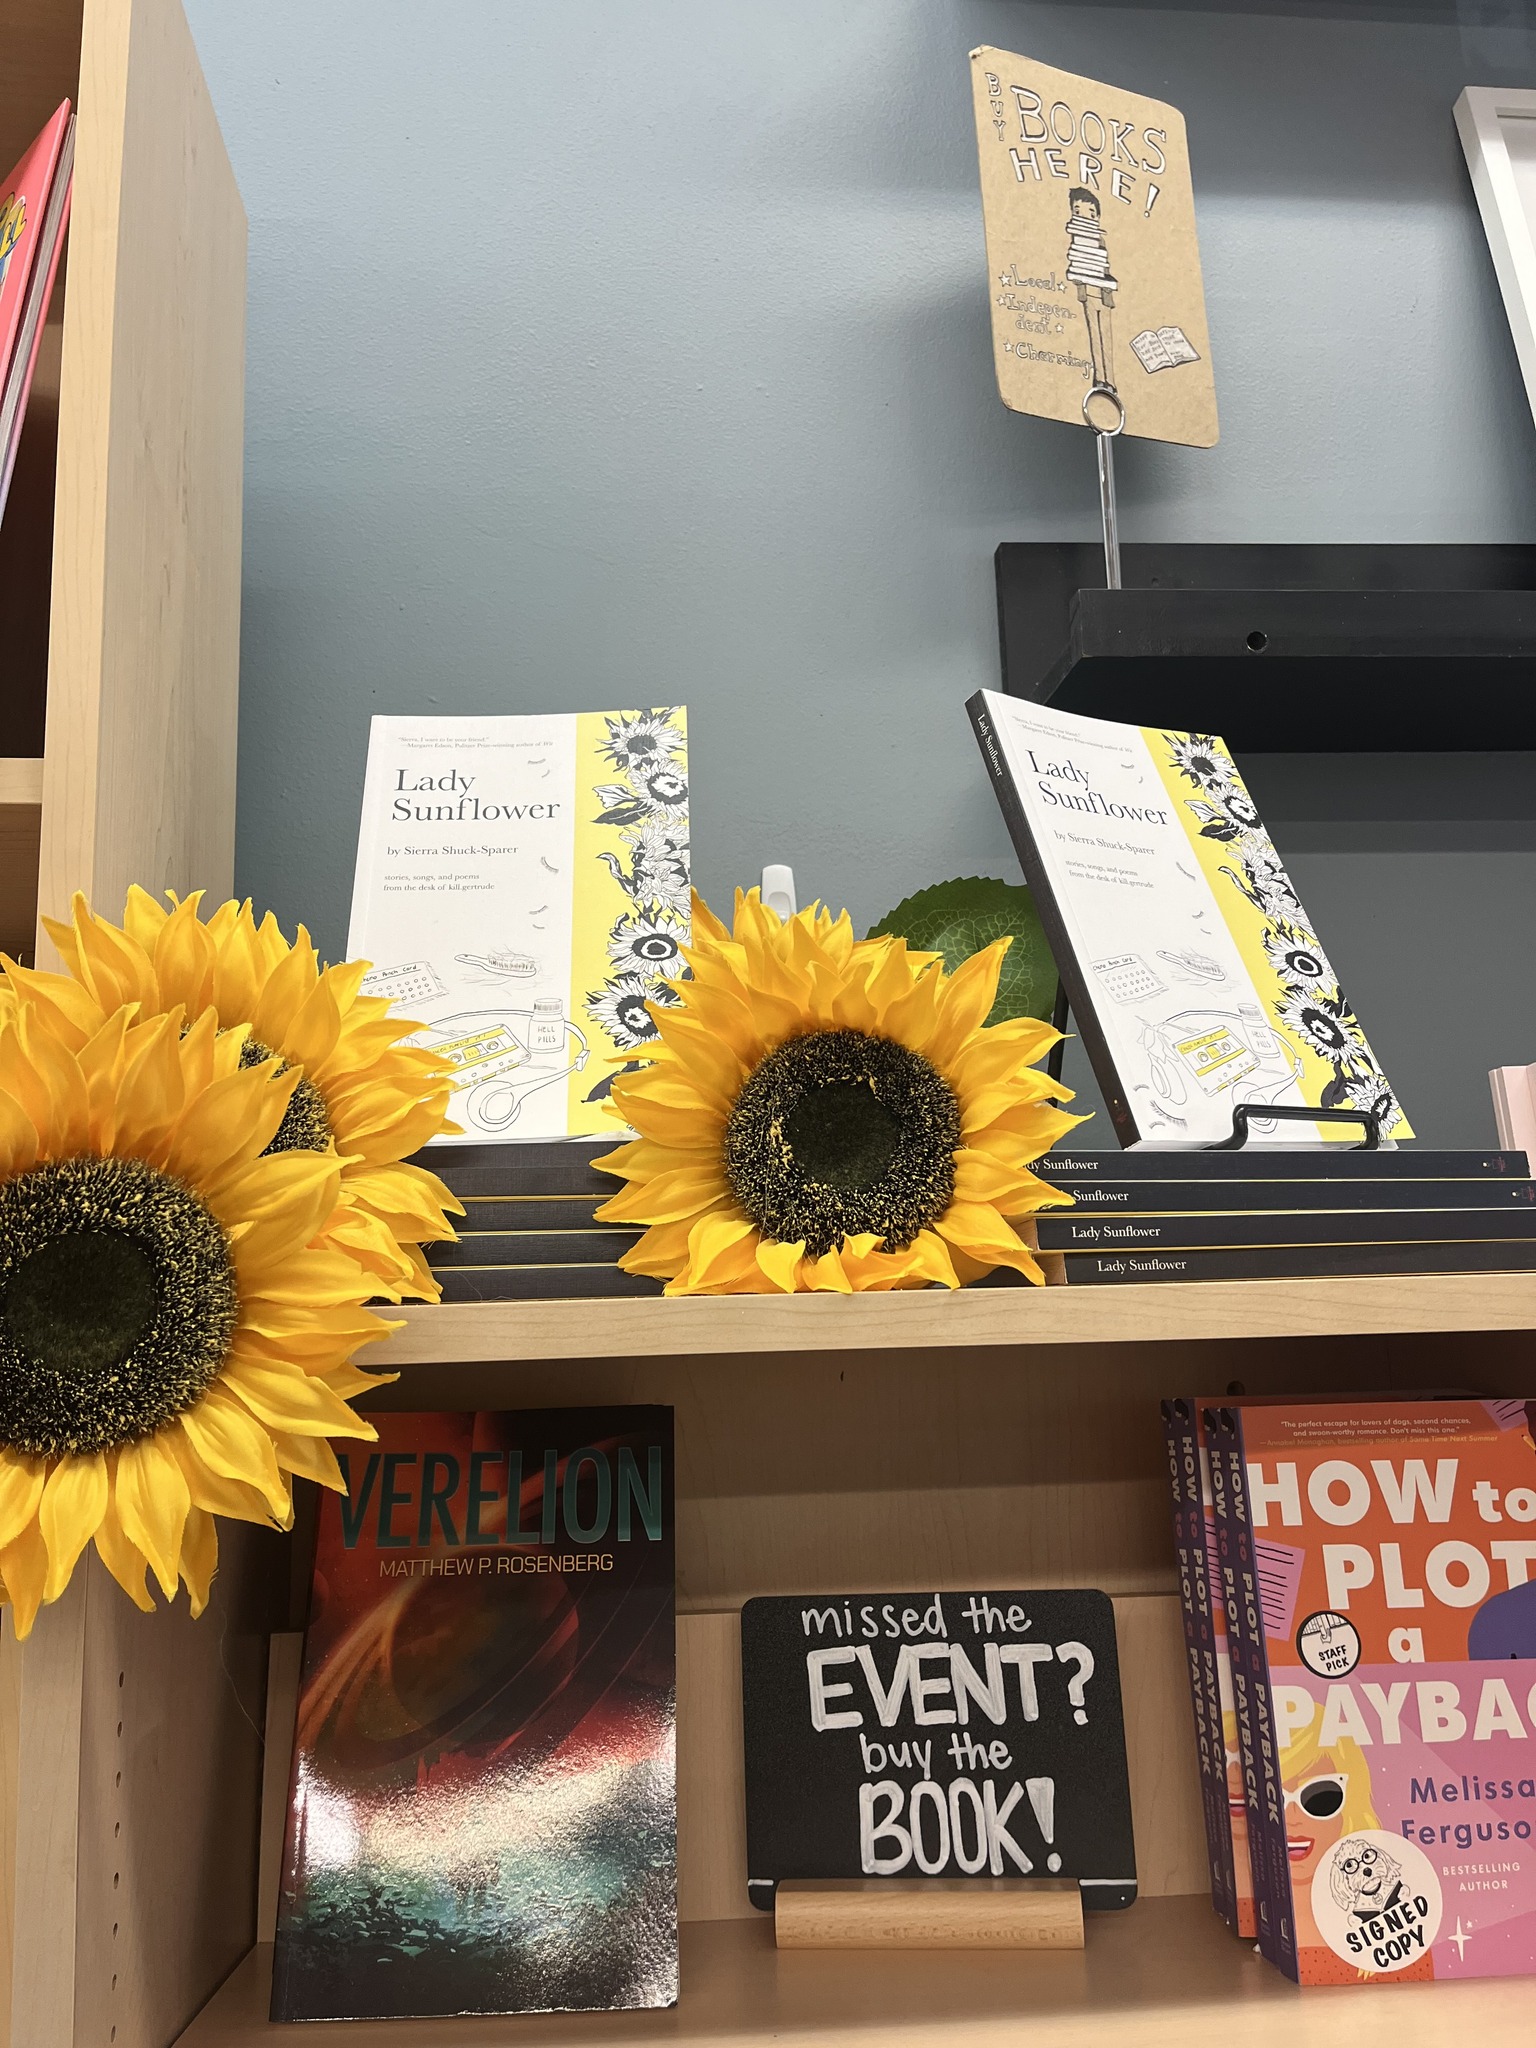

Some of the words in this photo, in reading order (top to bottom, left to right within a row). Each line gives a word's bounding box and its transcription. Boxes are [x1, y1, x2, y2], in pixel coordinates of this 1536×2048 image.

[985, 73, 1006, 141] BUY
[1010, 85, 1166, 175] BOOKS
[1009, 148, 1160, 218] HERE!
[1010, 264, 1055, 291] Local
[1015, 314, 1051, 335] dent
[1016, 342, 1094, 379] Charming
[978, 713, 989, 736] Lady
[985, 735, 1003, 777] Sunflower
[394, 769, 476, 798] Lady
[1025, 749, 1090, 791] Lady
[392, 798, 560, 821] Sunflower
[1038, 780, 1168, 825] Sunflower
[387, 846, 401, 857] by
[404, 846, 439, 855] Sierra
[442, 845, 519, 857] Shuck-Sparer
[1054, 830, 1066, 842] by
[1067, 832, 1095, 846] Sierra
[1096, 838, 1155, 855] Shuck-Sparer
[384, 874, 411, 882] stories,
[1023, 1158, 1040, 1172] dy
[1043, 1158, 1099, 1170] Sunflower
[1073, 1189, 1129, 1201] Sunflower
[1072, 1226, 1100, 1241] Lady
[1104, 1225, 1161, 1238] Sunflower
[1097, 1260, 1126, 1274] Lady
[1129, 1259, 1186, 1271] Sunflower
[1298, 1420, 1322, 1429] perfect
[1393, 1418, 1412, 1427] dogs,
[1309, 1429, 1355, 1437] swoon-worthy
[338, 1446, 662, 1550] VERELION
[1211, 1451, 1227, 1519] HOW
[1229, 1452, 1246, 1522] HOW
[1246, 1459, 1459, 1527] HOW
[1472, 1481, 1536, 1523] to
[1219, 1527, 1228, 1557] to
[1238, 1532, 1247, 1561] to
[380, 1559, 474, 1577] MATTHEW
[478, 1558, 492, 1575] P.
[497, 1553, 614, 1575] ROSENBERG
[802, 1593, 948, 1638] missed
[961, 1596, 1032, 1634] the
[1167, 1440, 1181, 1503] HOW
[1179, 1548, 1193, 1615] PLOT
[1189, 1647, 1211, 1776] PAYBACK
[1182, 1436, 1198, 1502] HOW
[1193, 1548, 1208, 1617] PLOT
[1203, 1650, 1224, 1783] PAYBACK
[1223, 1567, 1240, 1638] PLOT
[1242, 1573, 1259, 1647] PLOT
[1318, 1644, 1347, 1661] STAFF
[1388, 1627, 1425, 1663] a
[1326, 1657, 1349, 1672] PICK
[806, 1641, 1095, 1732] EVENT?
[1271, 1678, 1536, 1747] PAYBA
[859, 1733, 931, 1780] buy
[947, 1732, 1013, 1770] the
[1235, 1673, 1259, 1811] PAYBACK
[1254, 1682, 1280, 1826] PAYBACK
[1410, 1775, 1536, 1804] Melissa
[859, 1776, 1062, 1876] BOOK!
[1401, 1819, 1536, 1849] Ferguso
[1442, 1862, 1520, 1876] BESTSELLING
[1459, 1880, 1508, 1892] AUTHOR
[1346, 1895, 1428, 1953] SIGNED
[1373, 1924, 1425, 1968] COPY
